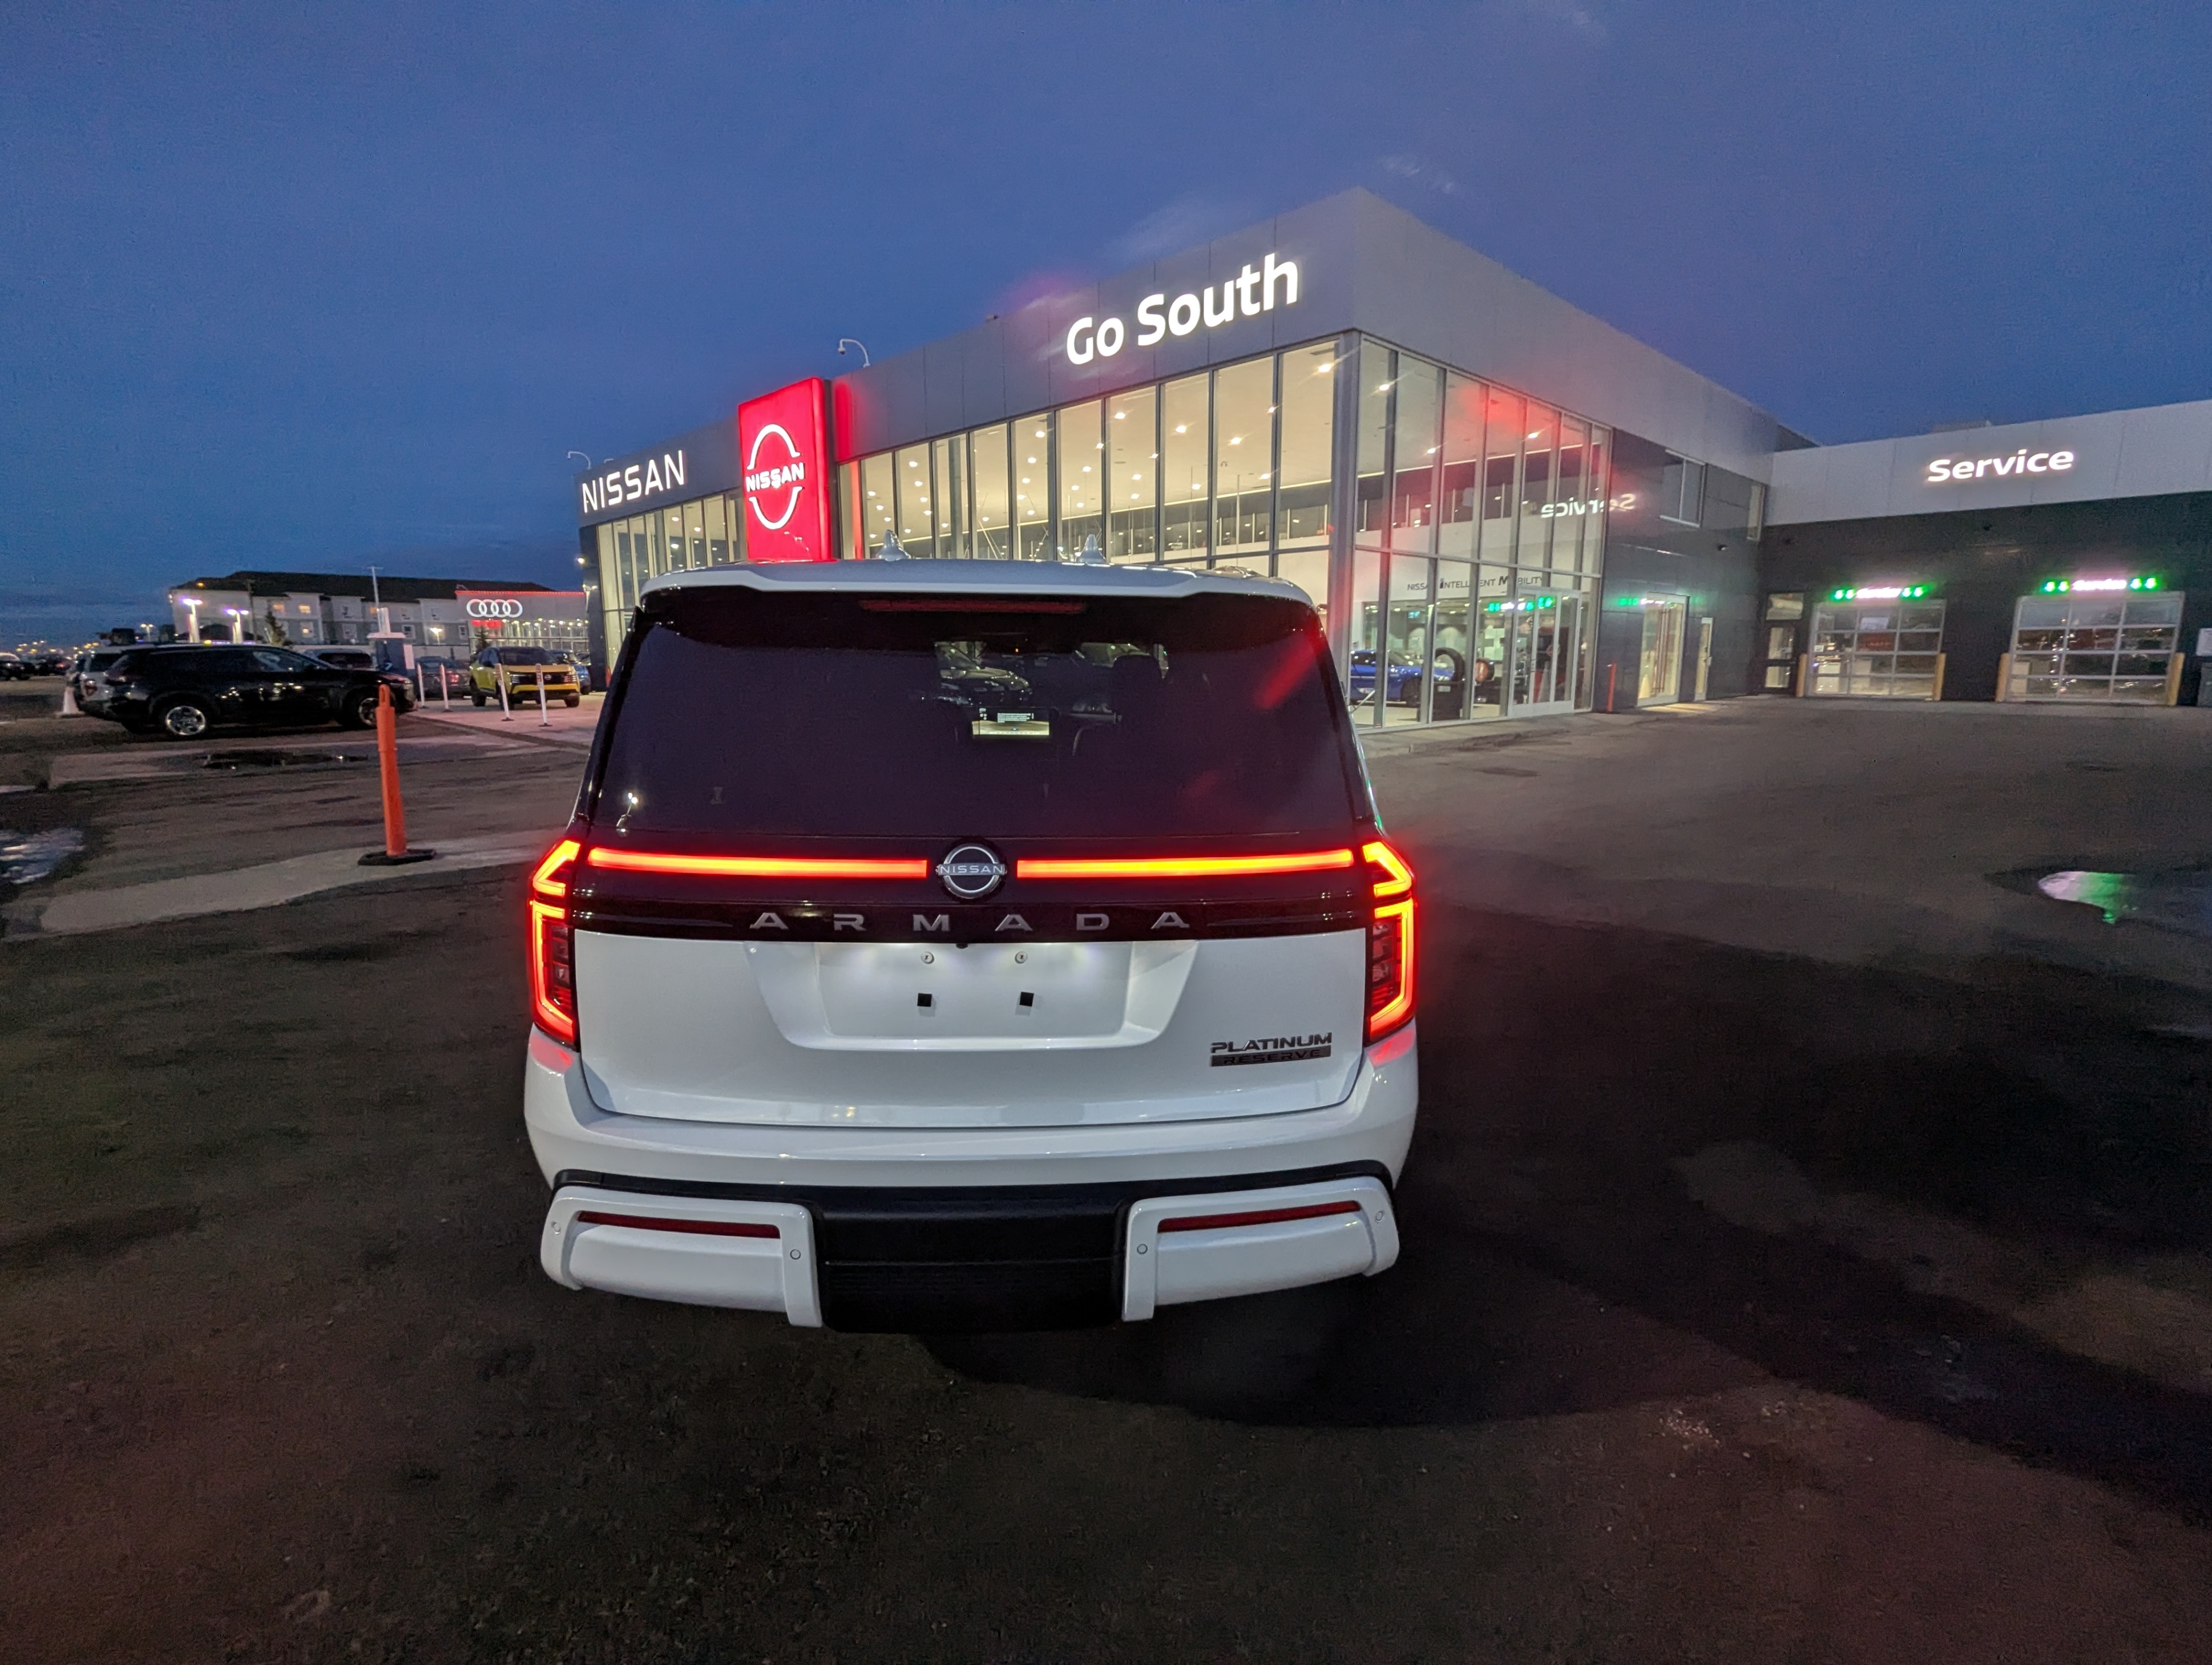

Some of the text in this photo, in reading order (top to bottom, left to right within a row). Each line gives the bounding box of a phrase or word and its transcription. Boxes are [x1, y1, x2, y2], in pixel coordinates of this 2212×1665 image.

[1067, 253, 1298, 365] Go South
[745, 462, 805, 492] NISSAN
[1928, 448, 2074, 482] Service
[582, 450, 684, 513] NISSAN
[749, 912, 1190, 931] ARMADA
[1211, 1032, 1332, 1053] PLATINUM
[1224, 1049, 1320, 1065] RESERVE
